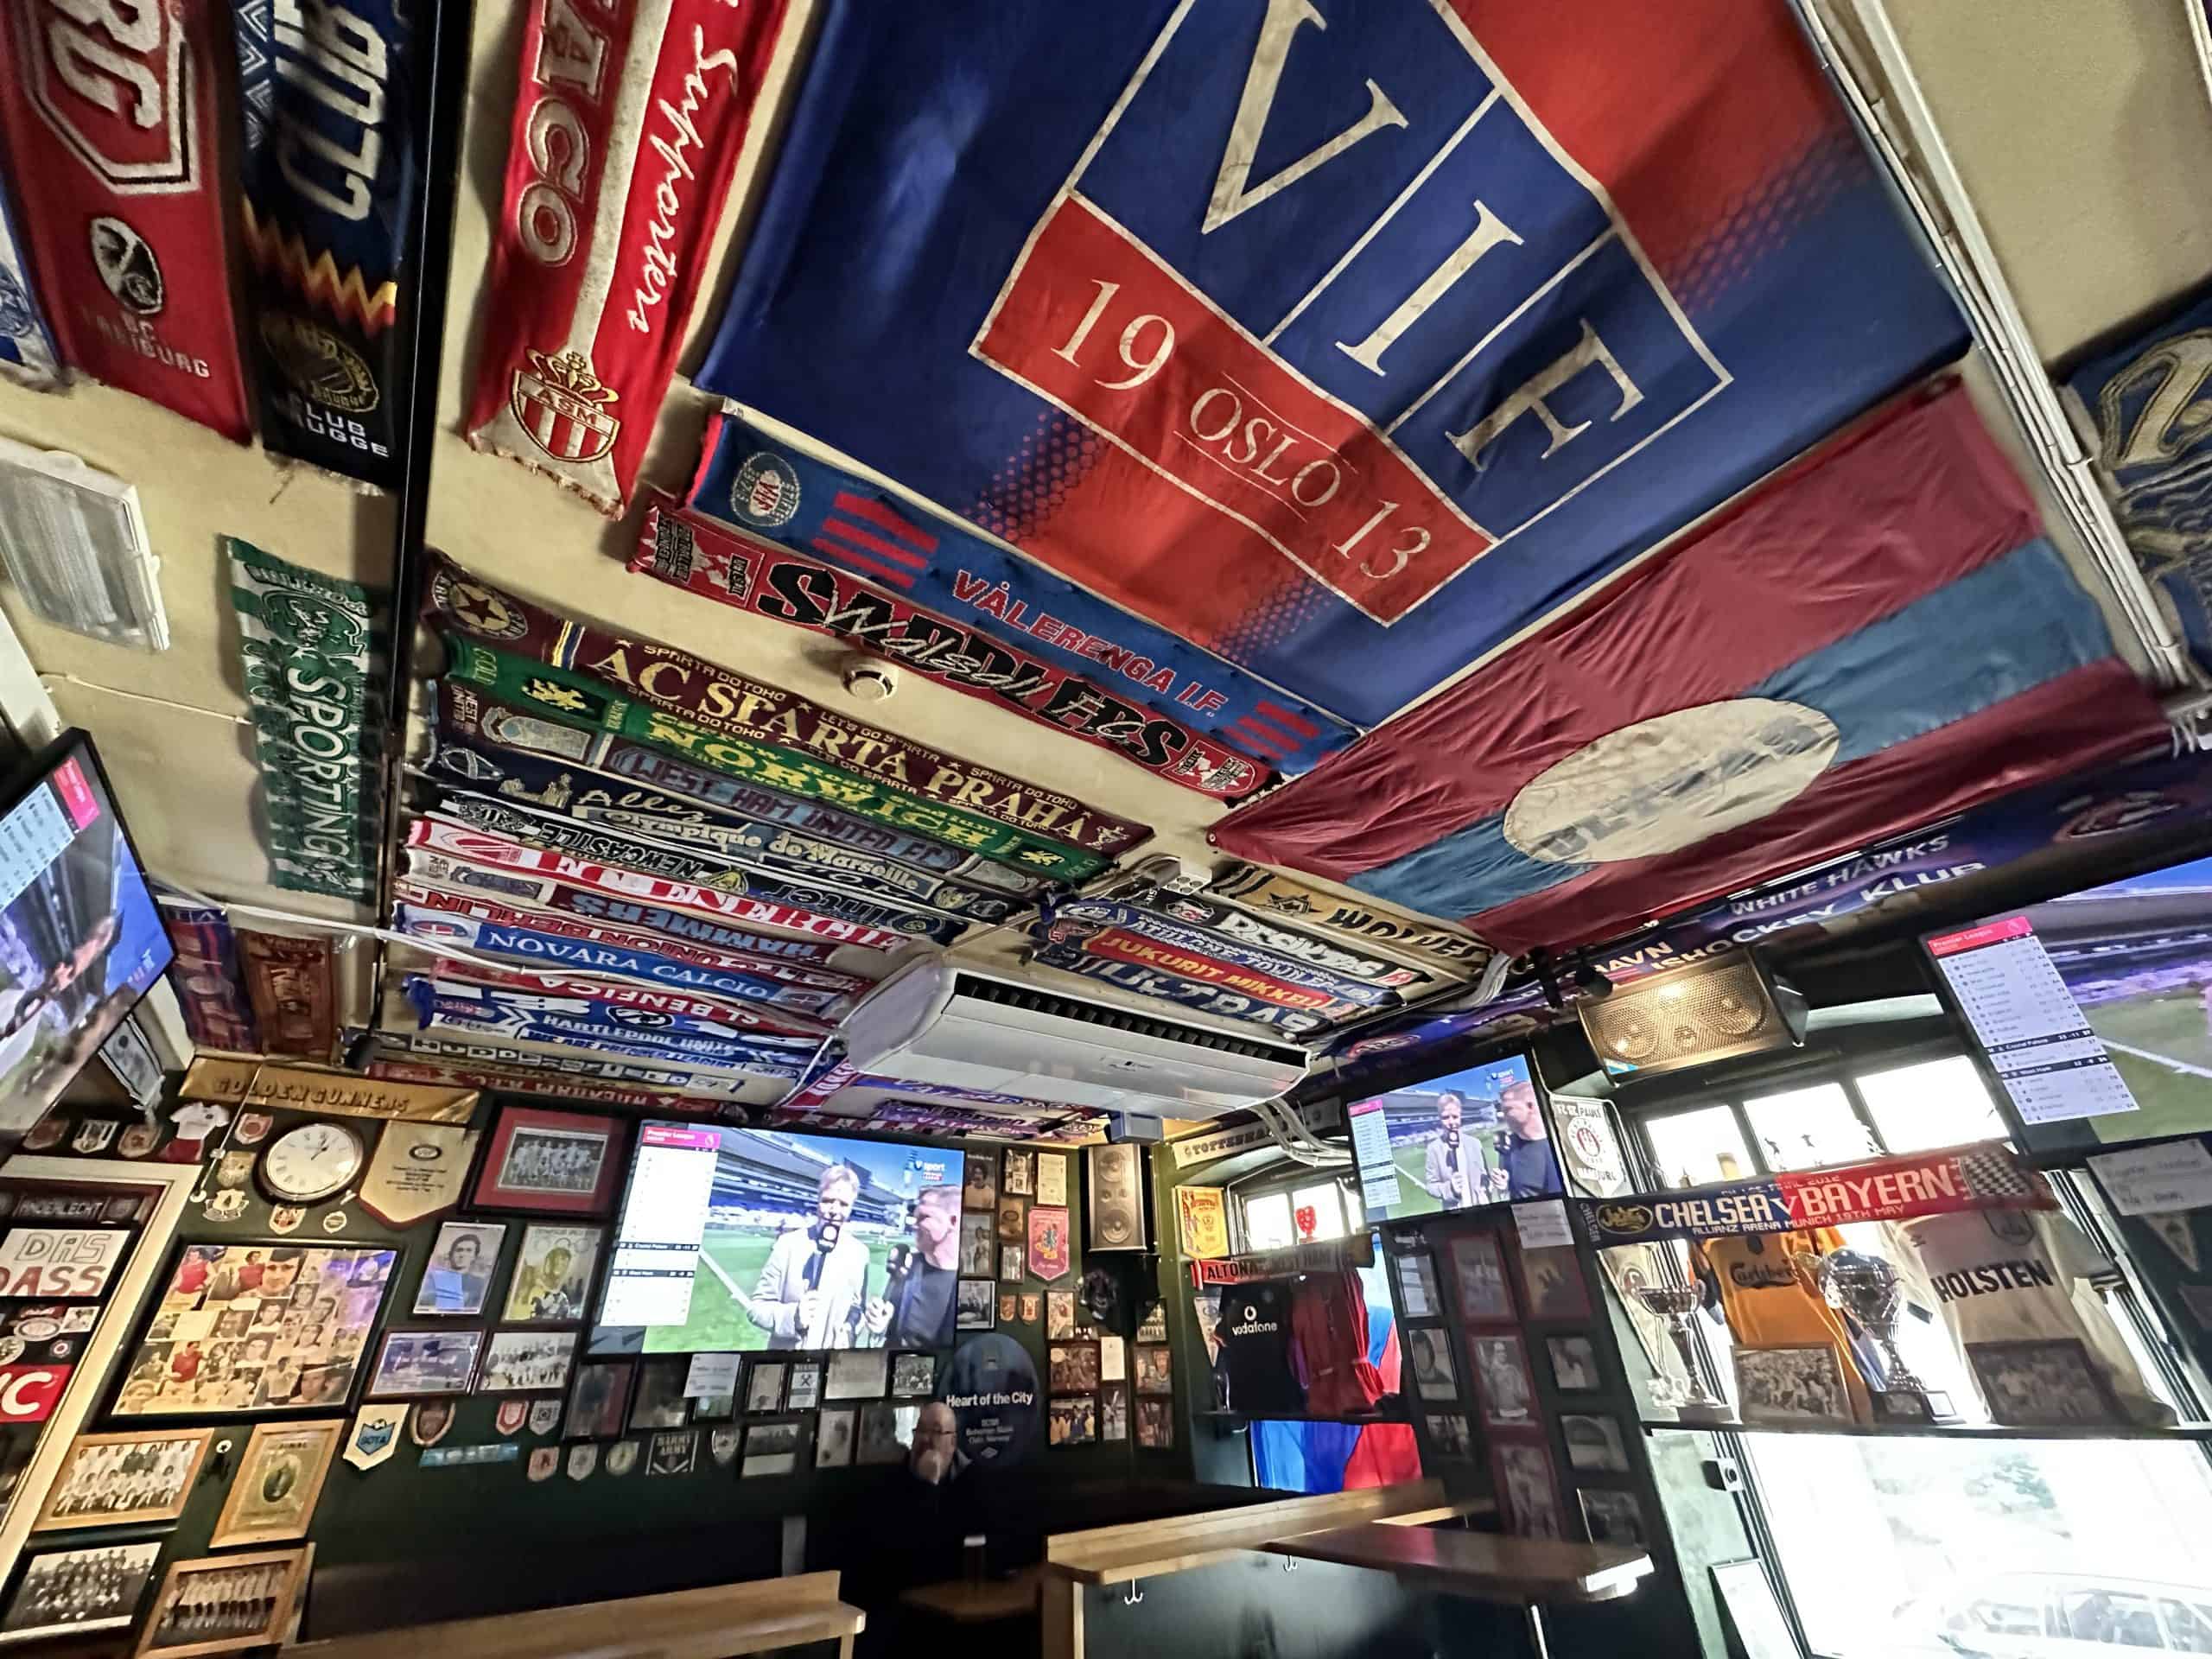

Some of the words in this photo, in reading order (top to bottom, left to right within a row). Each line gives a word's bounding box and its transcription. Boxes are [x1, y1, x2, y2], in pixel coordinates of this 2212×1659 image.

[1050, 278, 1176, 391] 19
[1190, 386, 1341, 508] OSLO
[1332, 499, 1432, 581] 13
[952, 569, 1180, 694] VÅLERENGA
[644, 645, 715, 678] SPARTA
[716, 670, 741, 686] DO
[744, 678, 787, 702] TOHO
[586, 648, 690, 702] AC
[696, 681, 908, 783] SPARTA
[923, 765, 1085, 842] PRAHA
[697, 714, 722, 728] DO
[724, 721, 766, 740] TOHO
[861, 728, 881, 741] GO
[284, 664, 356, 863] SPORTING
[648, 722, 993, 848] NORWICH
[969, 767, 1023, 792] SPARTA
[1024, 787, 1045, 799] DO
[538, 821, 705, 880] NEWCASTLE
[1731, 876, 1818, 917] WHITE
[1821, 834, 1952, 888] HAWKS
[1859, 860, 1987, 901] KLUB
[424, 890, 594, 938] BERLIN
[570, 893, 818, 959] HAMMERS
[489, 931, 640, 972] NOVARA
[652, 964, 769, 997] CALCIO
[599, 931, 725, 969] UNION
[1101, 937, 1225, 979] JUKURIT
[1224, 974, 1325, 1008] MIKKELI
[538, 976, 714, 1018] BENFICA
[542, 1014, 675, 1046] HARTLEPOOL
[213, 1076, 311, 1102] GOLDEN
[1654, 1193, 1774, 1229] CHELSEA
[1797, 1164, 1957, 1217] BAYERN
[1692, 1224, 1739, 1236] ALLIANZ
[1742, 1221, 1782, 1232] ARENA
[1784, 1215, 1834, 1230] MUNICH
[1835, 1209, 1872, 1223] 19TH
[1873, 1204, 1905, 1216] MAY
[14, 1232, 113, 1264] DAS
[1206, 1263, 1258, 1281] ALTONA
[1930, 1259, 2054, 1303] HOLSTEN
[1231, 1319, 1279, 1337] vodafone
[945, 1394, 979, 1408] Heart
[979, 1393, 993, 1406] of
[993, 1392, 1010, 1405] the
[1012, 1391, 1033, 1407] City
